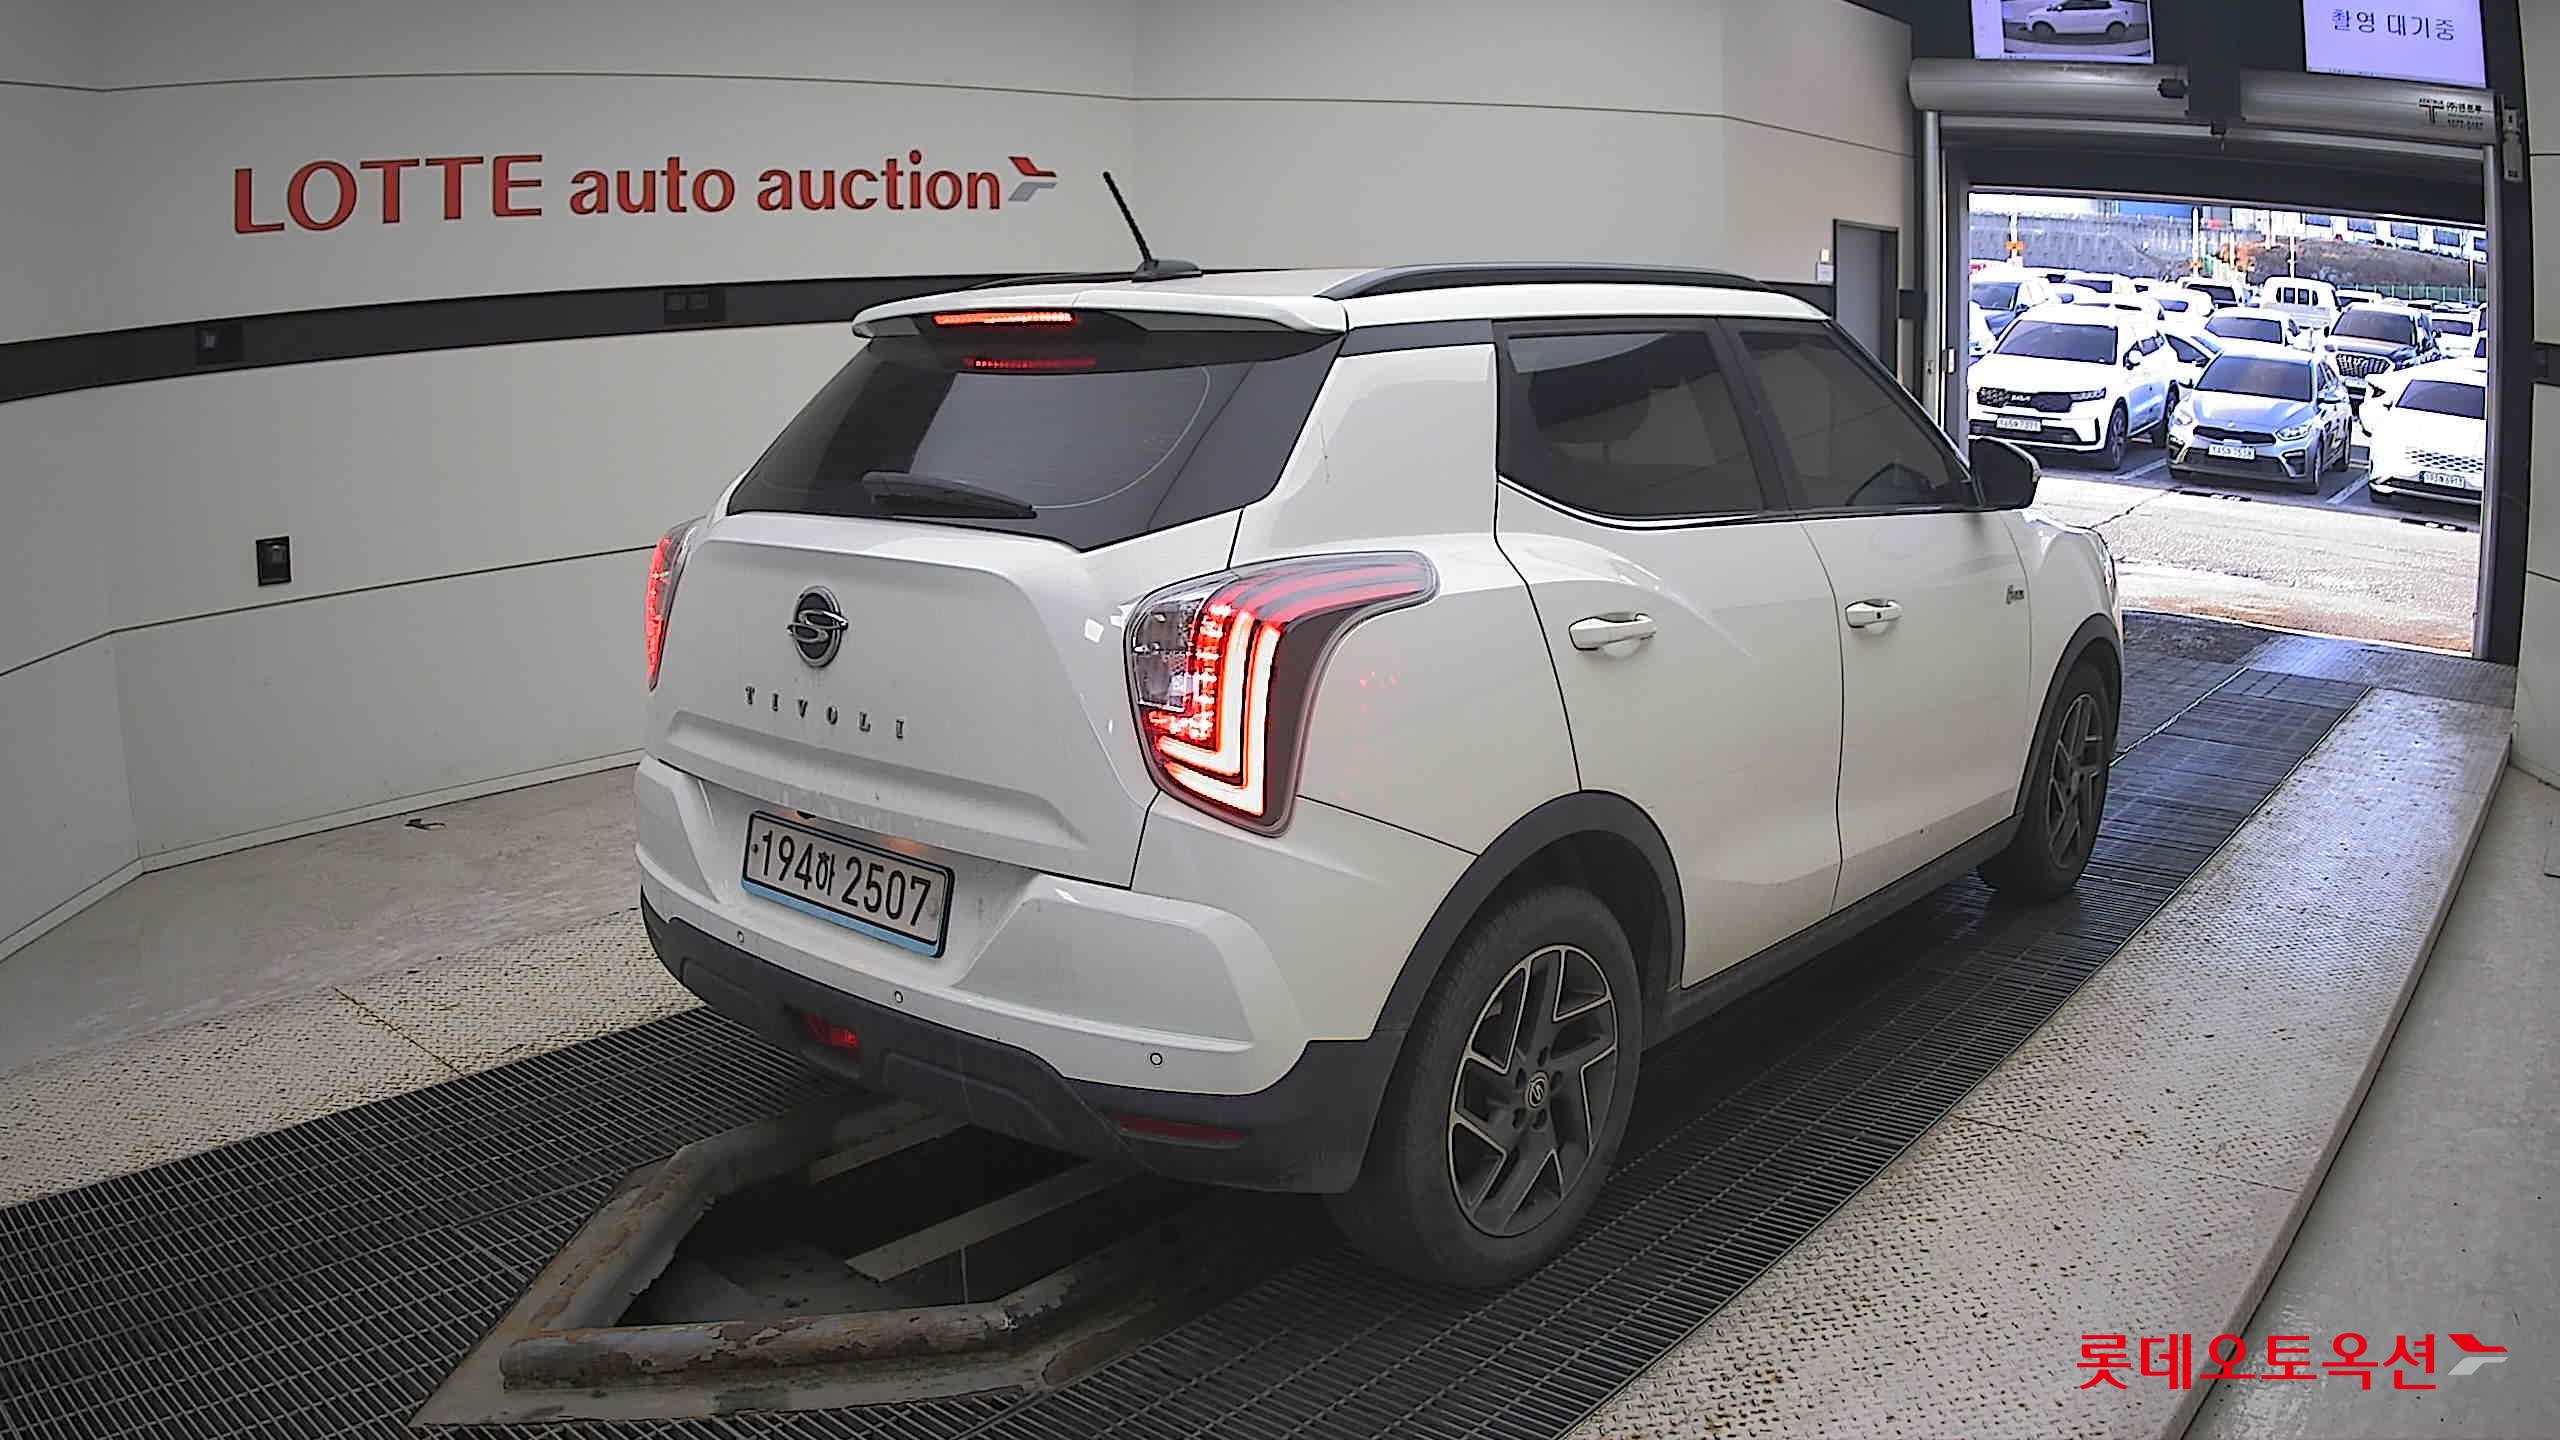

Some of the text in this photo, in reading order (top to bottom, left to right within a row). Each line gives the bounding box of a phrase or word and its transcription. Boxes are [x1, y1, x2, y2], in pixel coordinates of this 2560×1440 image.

[2387, 13, 2455, 41] 대기중
[236, 150, 1002, 233] LOTTE auto auction
[745, 686, 904, 740] TIVOLI
[762, 829, 931, 926] 194하 2507
